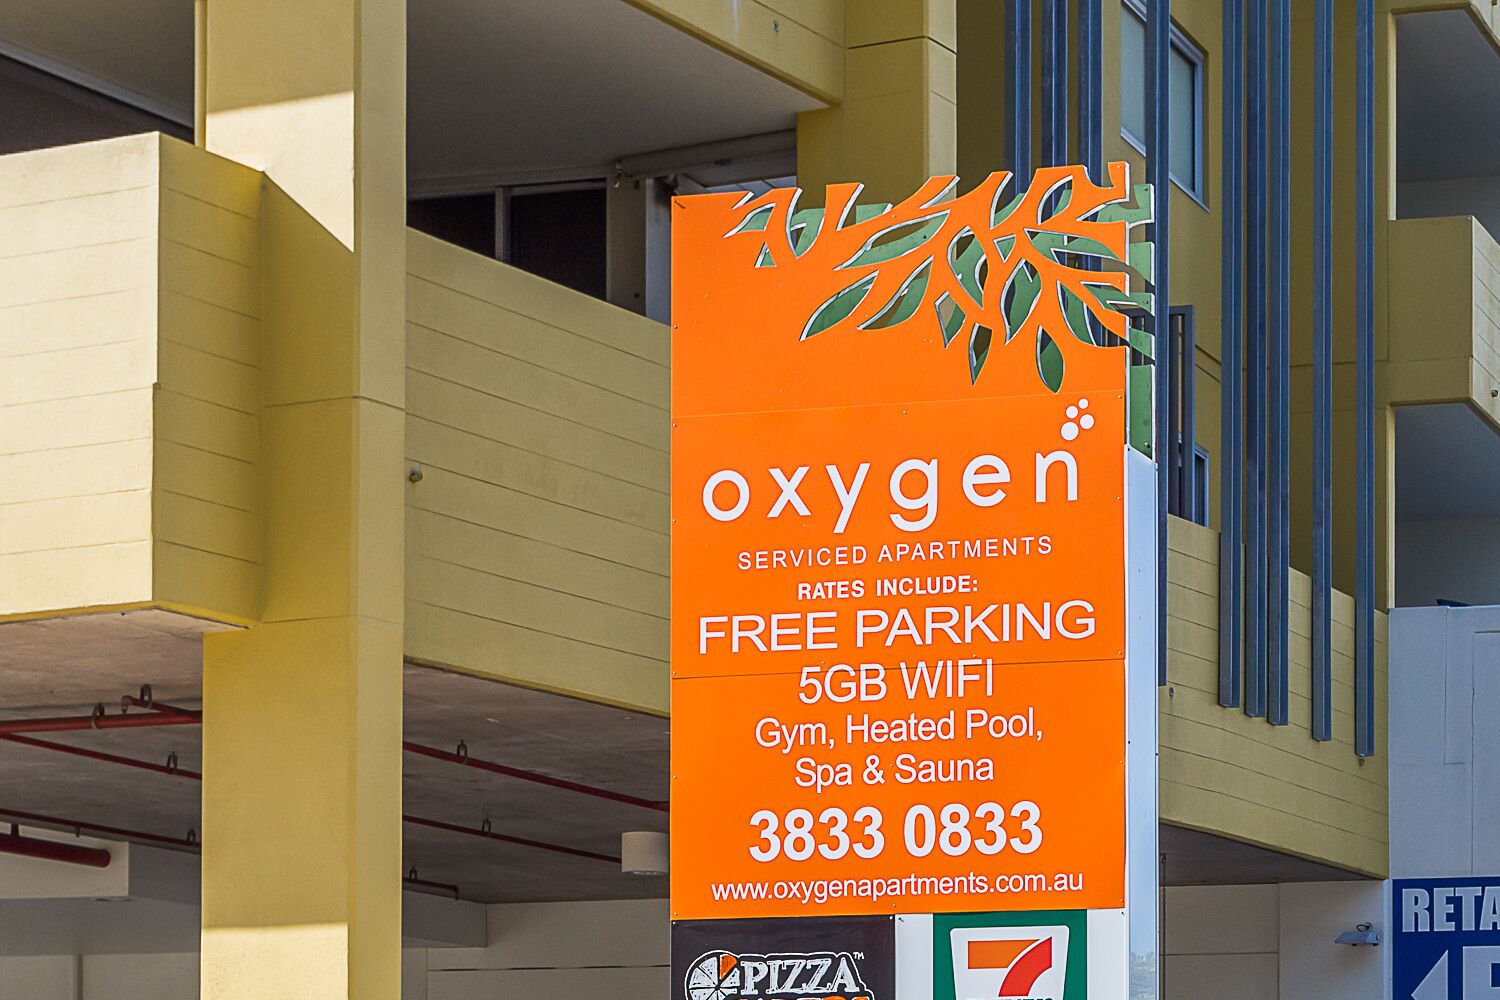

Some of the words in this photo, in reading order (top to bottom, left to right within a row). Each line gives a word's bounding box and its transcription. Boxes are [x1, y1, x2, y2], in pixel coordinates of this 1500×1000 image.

[702, 450, 1078, 533] oxygen
[738, 546, 867, 570] SERVICED
[878, 536, 1052, 563] APARTMENTS
[798, 580, 865, 600] RATES
[876, 576, 978, 596] INCLUDE:
[700, 611, 838, 654] FREE
[856, 600, 1096, 648] PARKING
[799, 664, 887, 704] 5GB
[900, 659, 993, 700] WIFI
[755, 717, 834, 754] Gym,
[846, 711, 954, 743] Heated
[966, 707, 1043, 742] Pool,
[795, 757, 852, 793] Spa
[862, 755, 885, 784] &
[895, 754, 994, 784] Sauna
[749, 806, 885, 862] 3833
[903, 801, 1043, 857] 0833
[711, 871, 1084, 904] www.oxygenapartments.com.au
[740, 957, 861, 996] PIZZA
